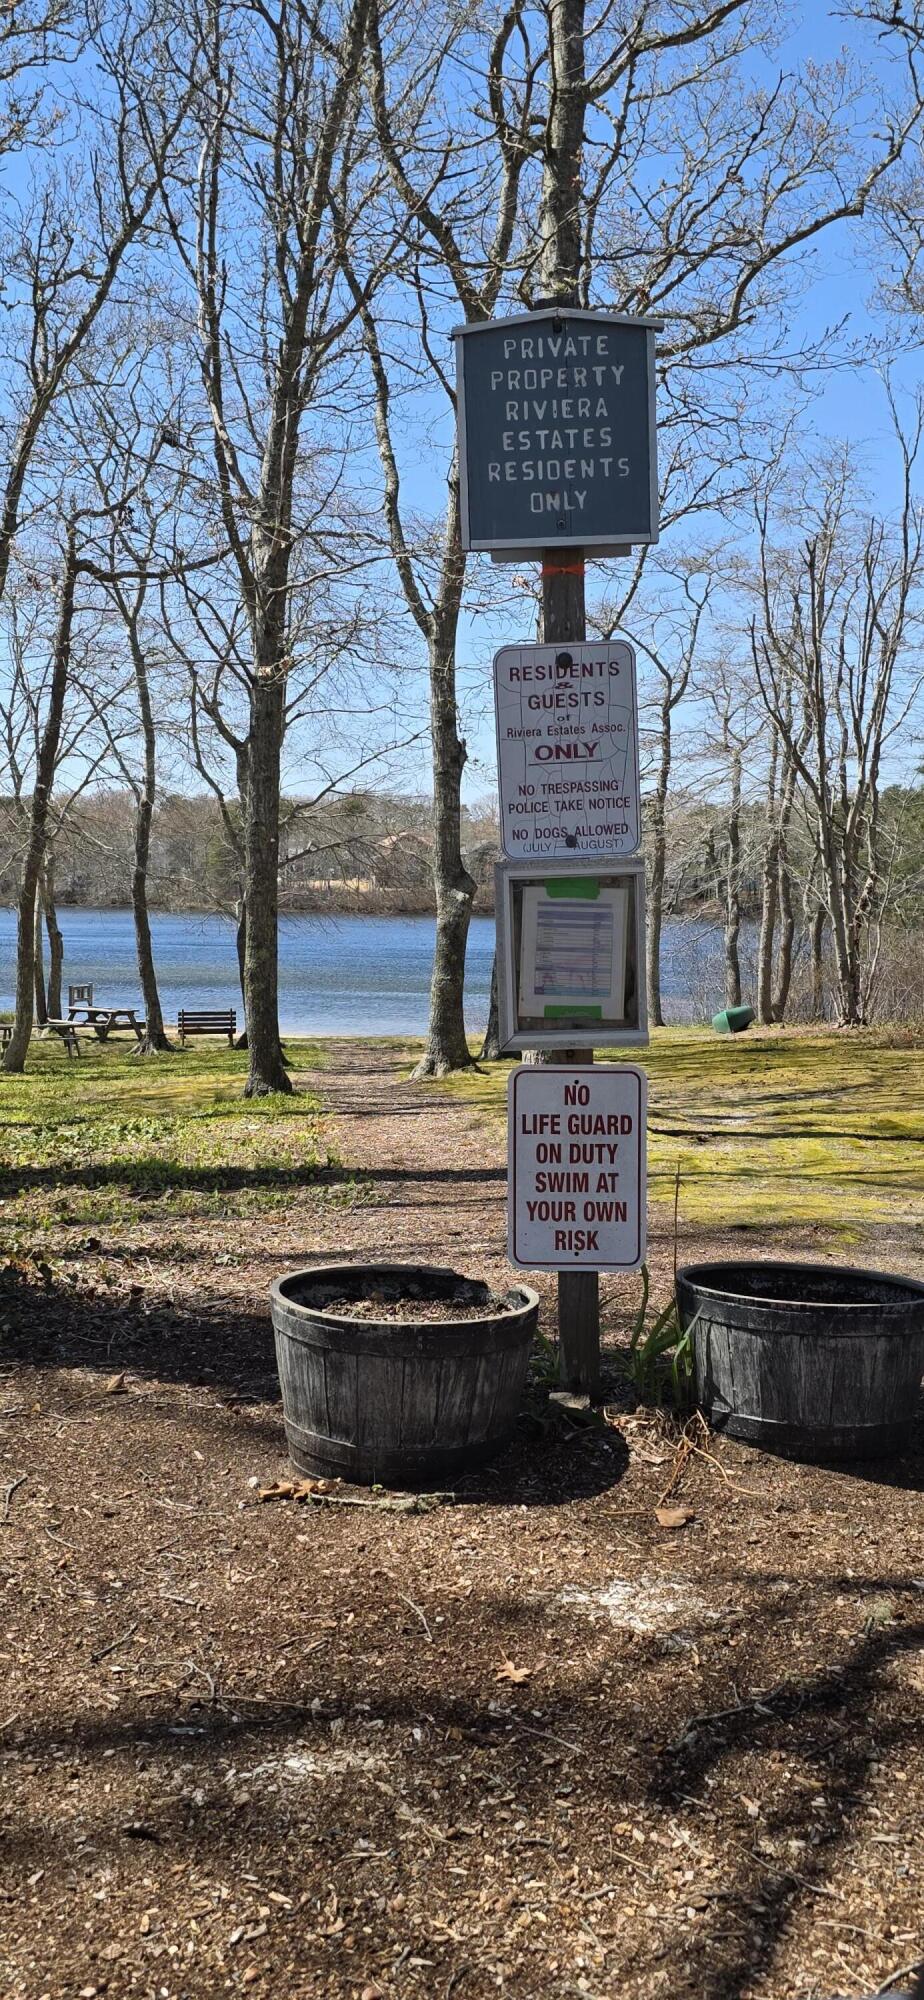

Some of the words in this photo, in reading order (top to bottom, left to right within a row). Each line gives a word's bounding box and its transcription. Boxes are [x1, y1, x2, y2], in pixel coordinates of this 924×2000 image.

[504, 336, 609, 359] PRIVATE
[491, 365, 625, 390] PROPERTY
[506, 398, 608, 421] RIVIERA
[502, 427, 612, 451] ESTATES
[488, 458, 630, 482] RESIDENTS
[530, 490, 587, 513] ONLY
[509, 661, 620, 682] RESIDENTS
[554, 682, 573, 690] &
[528, 691, 605, 710] GUESTS
[556, 714, 571, 722] of
[507, 727, 542, 738] Riviera
[547, 724, 586, 736] Estates
[591, 722, 626, 734] Assoc.
[534, 742, 599, 761] ONLY
[518, 784, 535, 796] NO
[541, 780, 619, 795] TRESPASSING
[508, 802, 549, 814] POLICE
[554, 799, 583, 811] TAKE
[588, 797, 631, 810] NOTICE
[512, 829, 529, 840] NO
[535, 826, 568, 839] DOGS
[574, 823, 629, 837] ALLOWED
[564, 1085, 590, 1106] NO
[521, 1114, 561, 1135] LIFE
[567, 1114, 633, 1135] GUARD
[536, 1143, 562, 1164] ON
[569, 1143, 618, 1164] DUTY
[535, 1172, 589, 1193] SWIM
[596, 1172, 619, 1193] AT
[526, 1201, 576, 1222] YOUR
[583, 1201, 627, 1222] OWN
[554, 1230, 600, 1251] RISK
